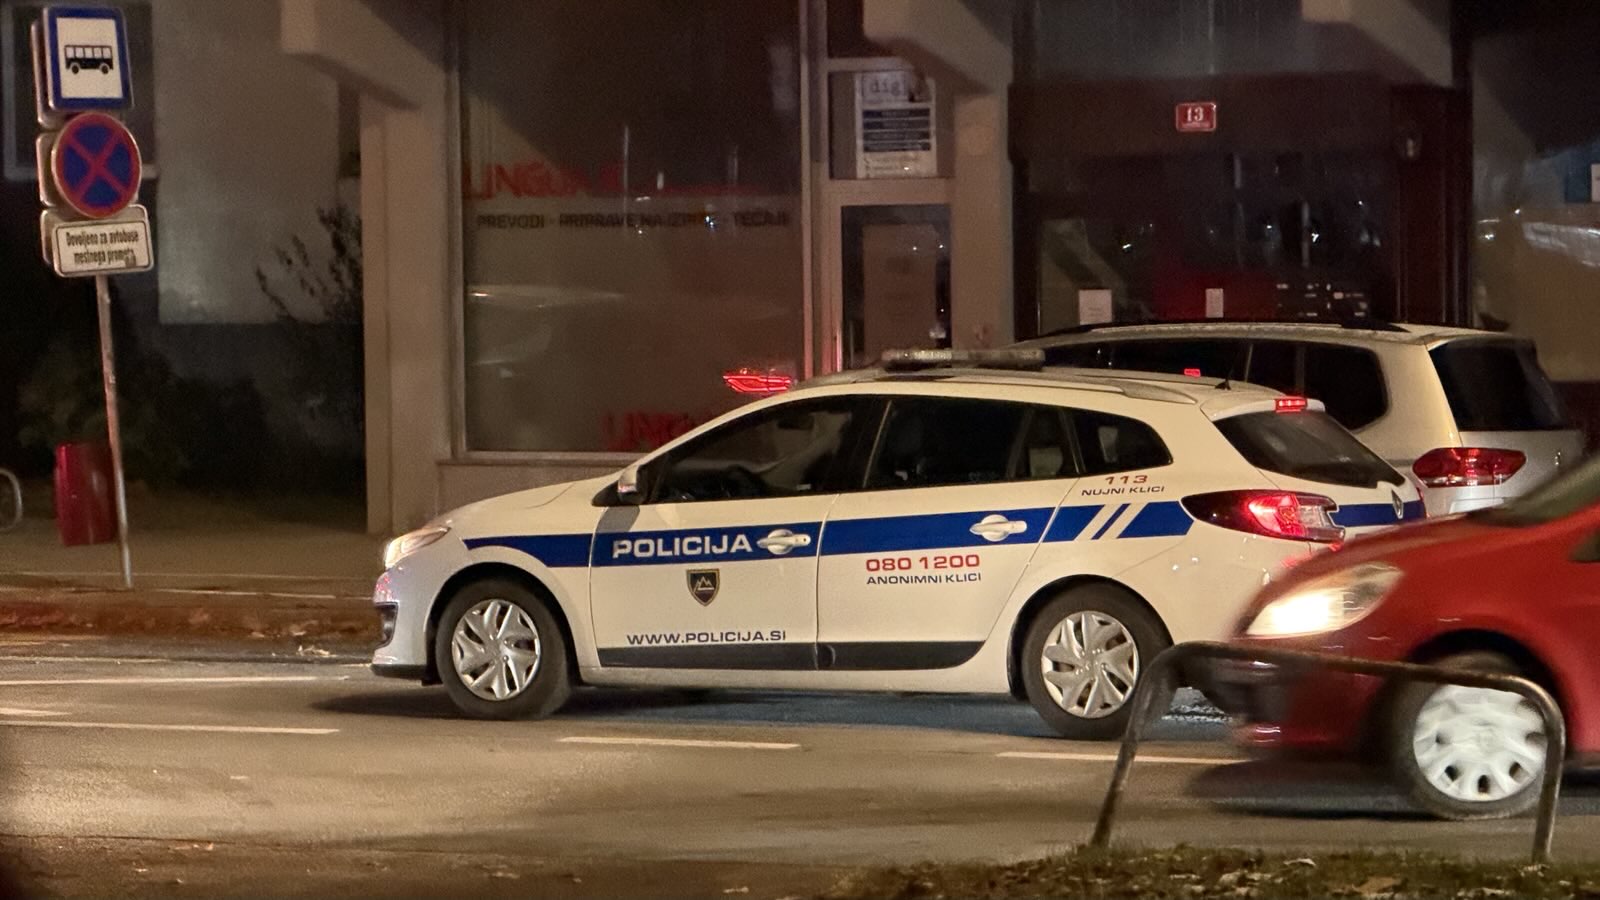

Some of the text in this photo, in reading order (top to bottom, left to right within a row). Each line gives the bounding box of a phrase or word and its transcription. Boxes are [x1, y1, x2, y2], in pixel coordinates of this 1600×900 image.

[1187, 107, 1204, 122] 13
[477, 213, 545, 229] PREVODI
[100, 232, 107, 244] za
[1104, 474, 1147, 485] 113
[1081, 484, 1165, 496] NUJNI KLICI
[612, 533, 753, 560] POLICIJA
[866, 554, 980, 572] 080 1200
[866, 573, 982, 585] ANONIMNI KLICI
[627, 630, 786, 645] WWW.POLICIJA.SI
